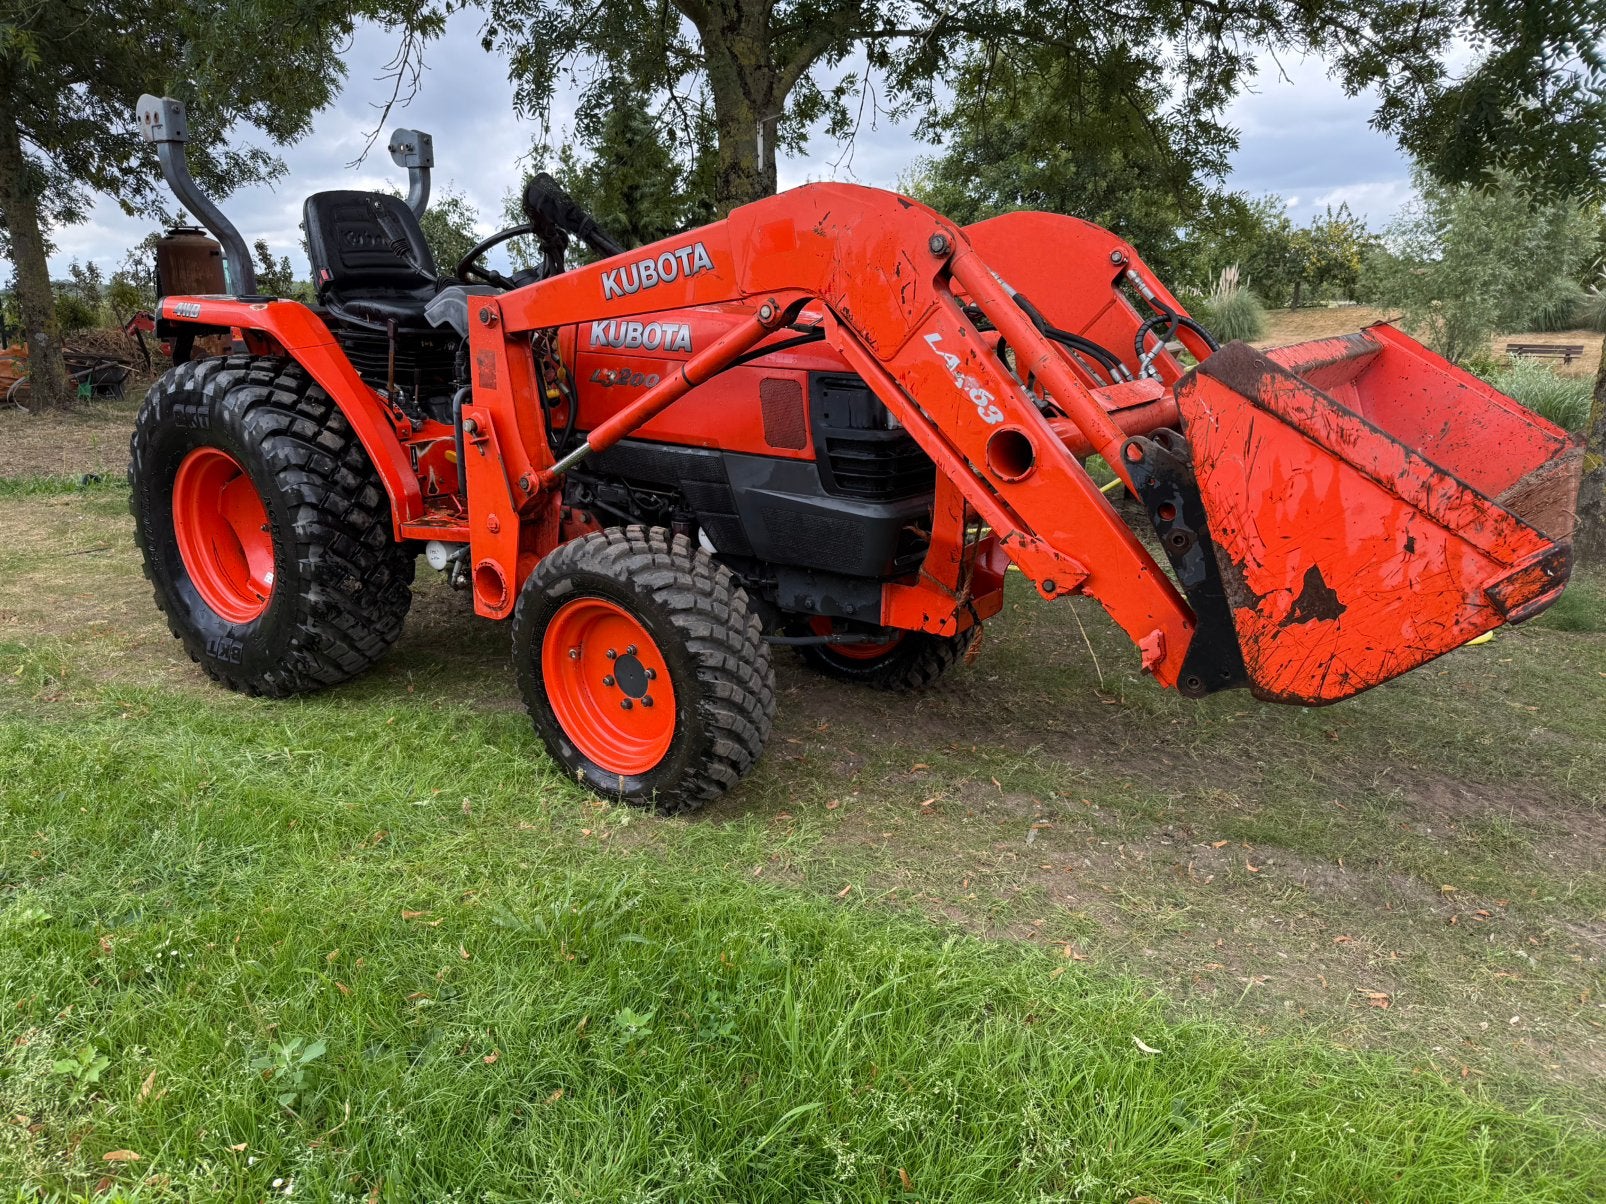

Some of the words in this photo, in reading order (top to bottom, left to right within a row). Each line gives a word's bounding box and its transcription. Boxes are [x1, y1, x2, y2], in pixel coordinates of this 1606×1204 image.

[601, 241, 715, 301] KUBOTA
[173, 302, 201, 319] 4WD
[590, 320, 692, 352] KUBOTA
[590, 367, 660, 388] L3200
[205, 636, 244, 665] BKT
